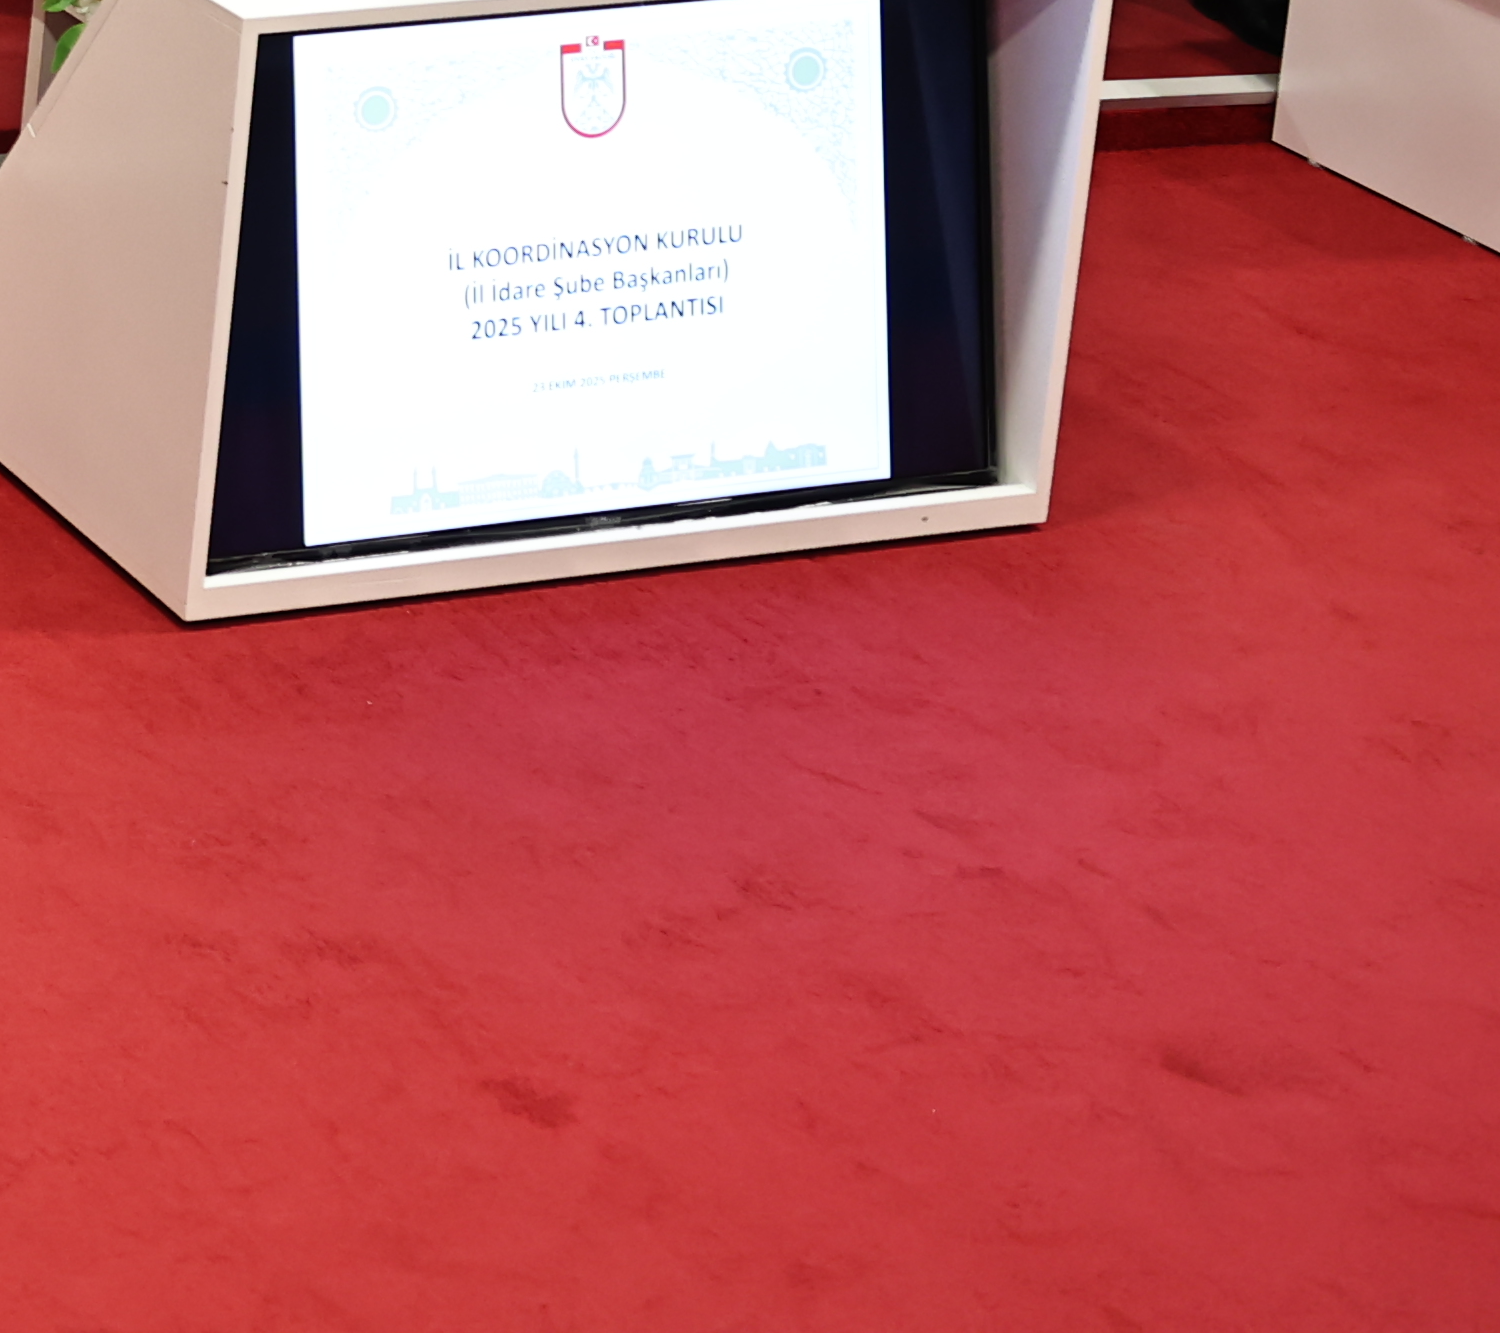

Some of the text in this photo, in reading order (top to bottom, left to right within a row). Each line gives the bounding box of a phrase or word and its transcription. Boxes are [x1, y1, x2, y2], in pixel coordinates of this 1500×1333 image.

[448, 224, 742, 271] İL KOORDİNASYON KURULU
[492, 278, 546, 302] İdare
[553, 274, 605, 301] Şube
[613, 258, 729, 293] Başkanları)
[471, 295, 723, 340] 2025 YILI 4. TOPLANTISI
